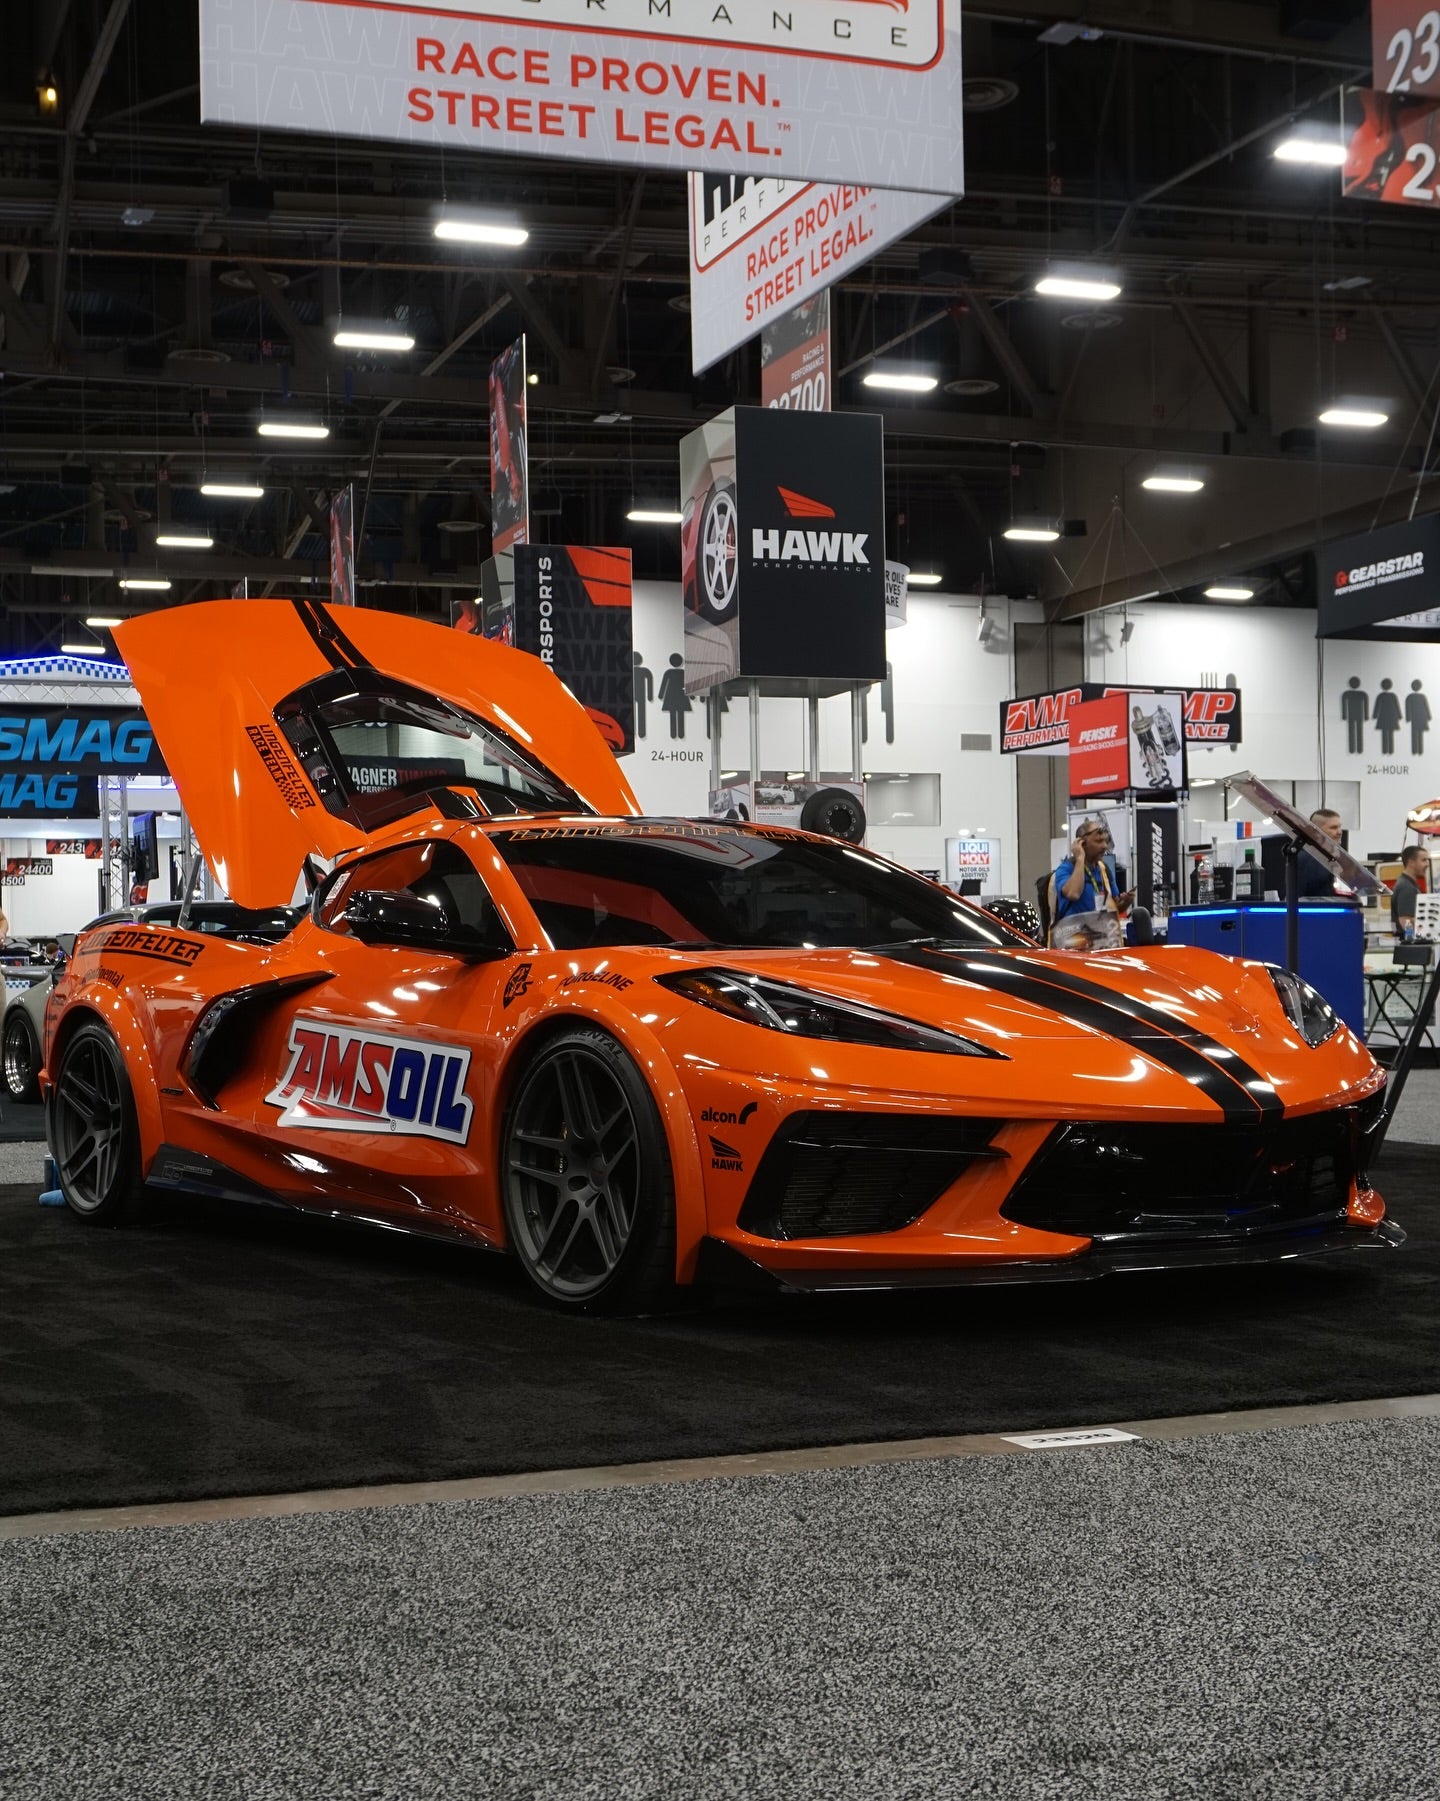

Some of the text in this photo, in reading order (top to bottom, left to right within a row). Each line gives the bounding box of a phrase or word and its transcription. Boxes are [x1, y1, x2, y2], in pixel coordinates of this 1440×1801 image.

[417, 37, 550, 84] RACE
[571, 54, 781, 107] PROVEN.
[407, 87, 596, 139] STREET
[747, 227, 788, 282] RACE
[745, 256, 805, 321] STREET
[791, 354, 825, 382] PERFORMANCE
[752, 528, 870, 564] HAWK
[752, 561, 872, 573] PERFORMANCE
[891, 571, 906, 585] OILS
[1348, 551, 1424, 584] GEARSTAR
[0, 717, 153, 763] SMAG
[1078, 724, 1119, 744] PENSKE
[248, 728, 285, 781] RACE TEAM
[259, 724, 316, 808] LINGENFELTER
[651, 750, 704, 762] 24-HOUR
[348, 767, 397, 786] AGNER
[1367, 764, 1409, 775] 24-HOUR
[960, 843, 988, 853] LIQUI
[960, 853, 989, 864] MOLY
[18, 864, 52, 875] 24400
[80, 930, 206, 961] LINGENFELTER
[555, 971, 635, 992] FORGELINE
[279, 1028, 467, 1134] AMSOIL
[701, 1106, 737, 1124] alcon
[711, 1158, 743, 1172] HAWK
